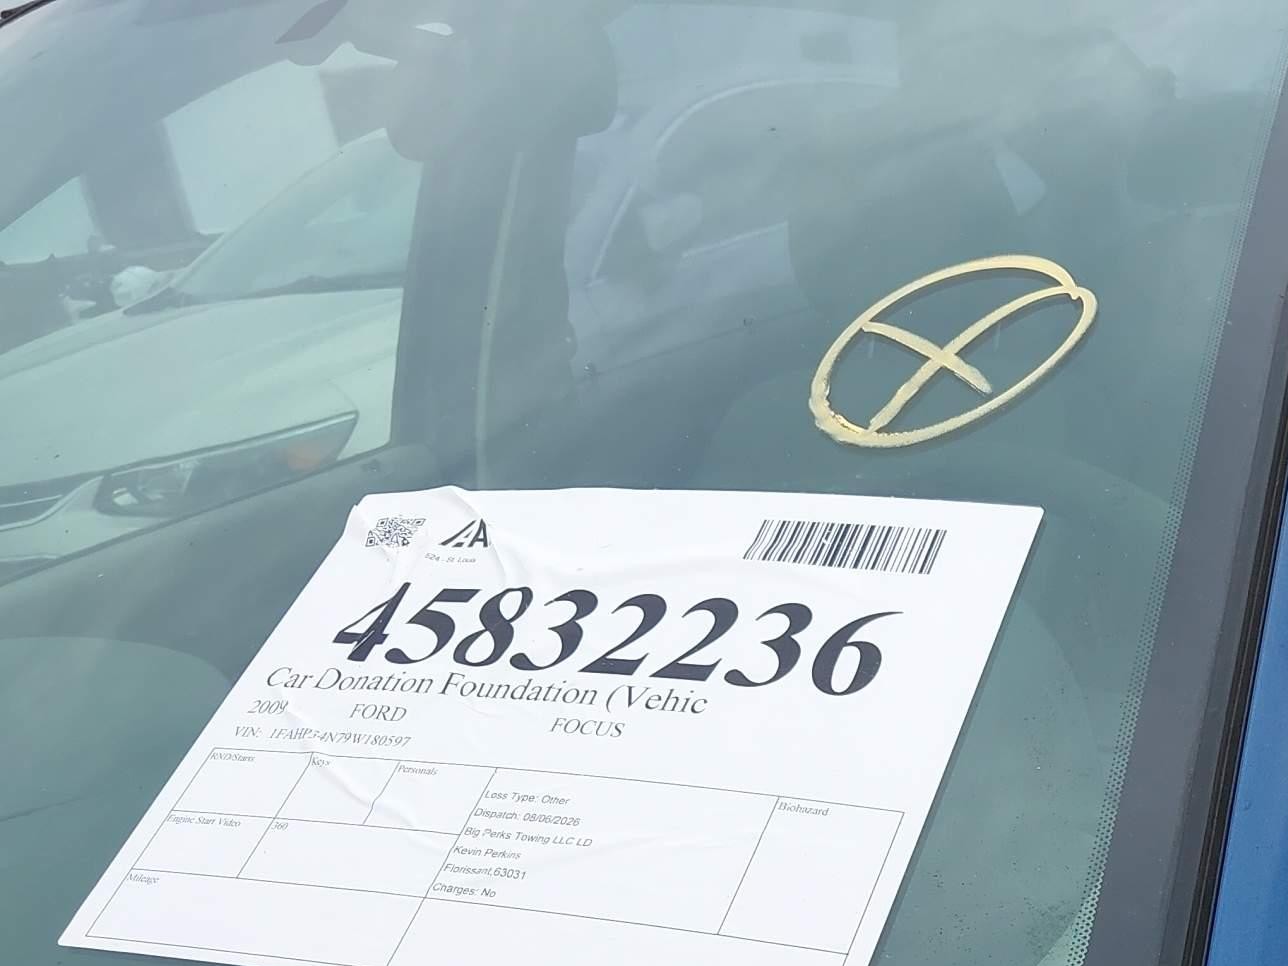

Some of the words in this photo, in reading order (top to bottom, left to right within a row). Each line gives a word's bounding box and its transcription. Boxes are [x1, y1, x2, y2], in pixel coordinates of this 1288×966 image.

[332, 581, 904, 696] 45832236
[266, 666, 313, 689] Car
[315, 667, 434, 693] Donation
[438, 672, 598, 706] Foundation
[606, 684, 708, 714] (Vehic
[247, 699, 289, 715] 2009
[349, 703, 407, 722] FORD
[549, 717, 626, 738] FOCUS
[234, 726, 262, 738] VIN:
[399, 764, 438, 776] Personals
[484, 790, 508, 800] Loss
[511, 791, 539, 803] Type:
[541, 794, 571, 805] Other
[778, 801, 830, 816] Biohazard
[168, 814, 196, 825] Engine
[198, 817, 215, 826] Start
[216, 818, 241, 828] Video
[474, 808, 520, 821] Dispatch:
[522, 811, 581, 827] 08/06/2026
[271, 821, 288, 831] 360
[464, 827, 481, 839] Big
[482, 828, 512, 840] Perks
[515, 831, 551, 844] Towing
[552, 835, 575, 845] LLC
[576, 838, 593, 847] LD
[453, 845, 482, 857] Kevin
[484, 848, 522, 860] Perkins
[432, 882, 479, 898] Charges:
[481, 887, 496, 898] No
